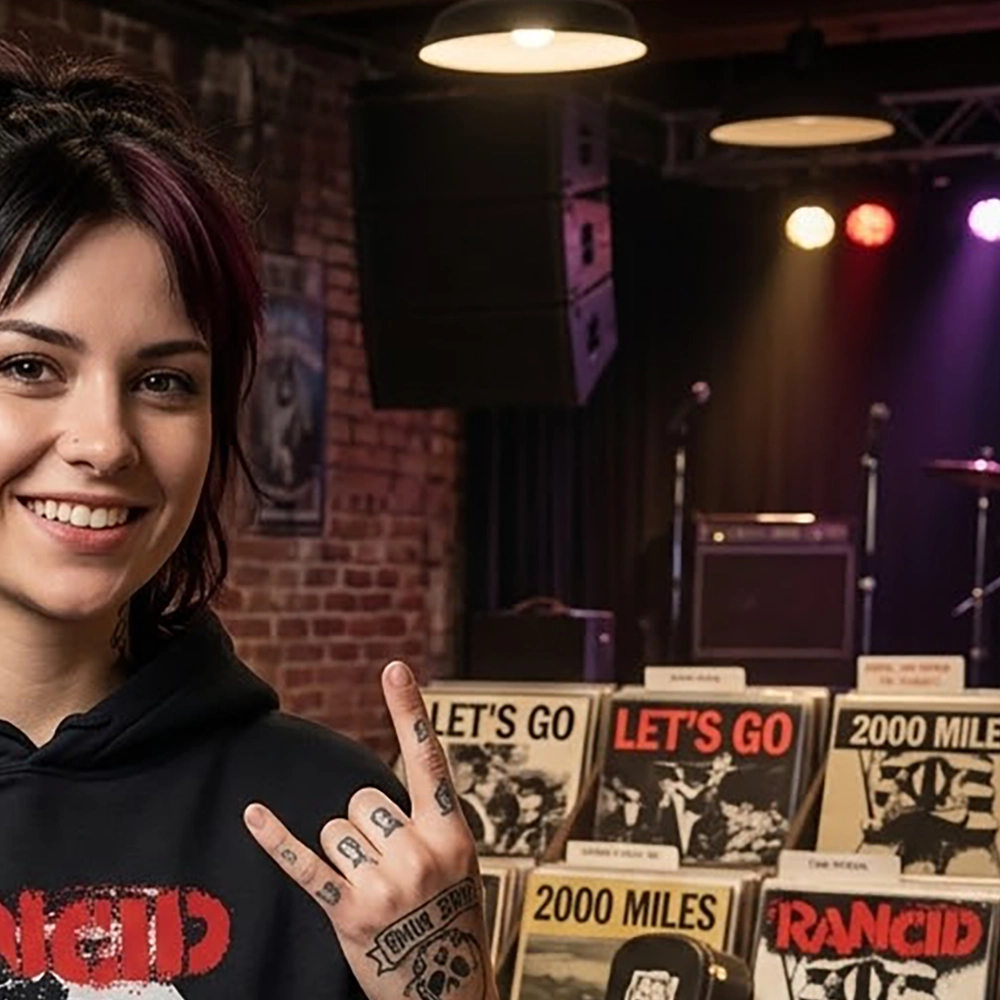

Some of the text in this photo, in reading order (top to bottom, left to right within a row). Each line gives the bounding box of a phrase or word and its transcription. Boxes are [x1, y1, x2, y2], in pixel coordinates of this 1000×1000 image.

[431, 702, 575, 741] LET'S GO
[614, 707, 793, 757] LET'S GO
[849, 714, 927, 747] 2000
[533, 884, 718, 931] 2000 MILES
[768, 898, 984, 958] RANCID
